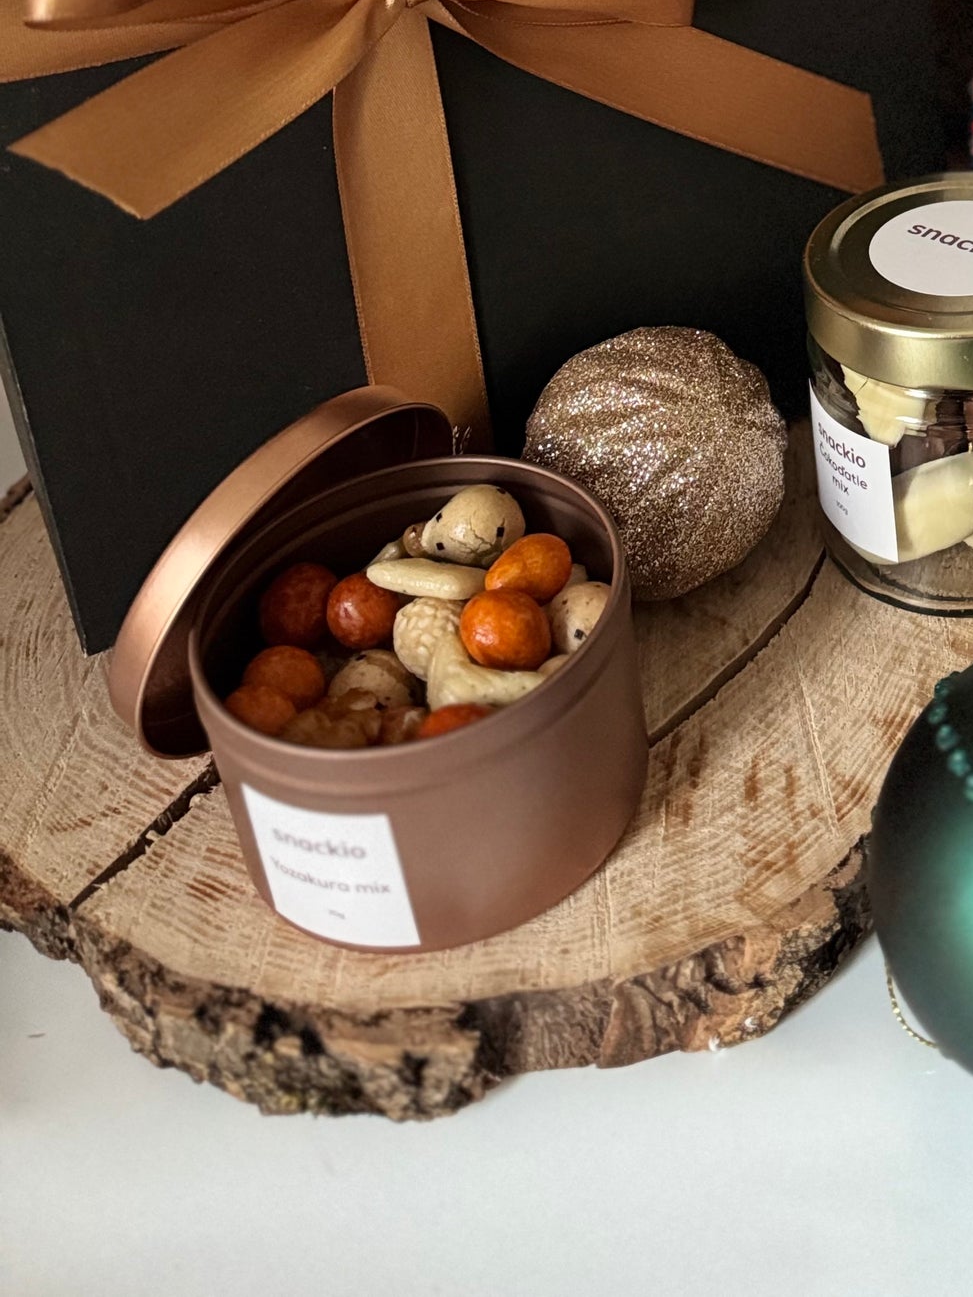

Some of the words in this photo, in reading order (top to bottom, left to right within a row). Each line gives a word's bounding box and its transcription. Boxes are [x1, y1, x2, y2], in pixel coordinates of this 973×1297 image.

[818, 422, 867, 469] snackio
[832, 475, 849, 495] mix
[271, 827, 367, 860] snackio
[270, 855, 350, 892] Yozakura
[356, 880, 391, 894] mix
